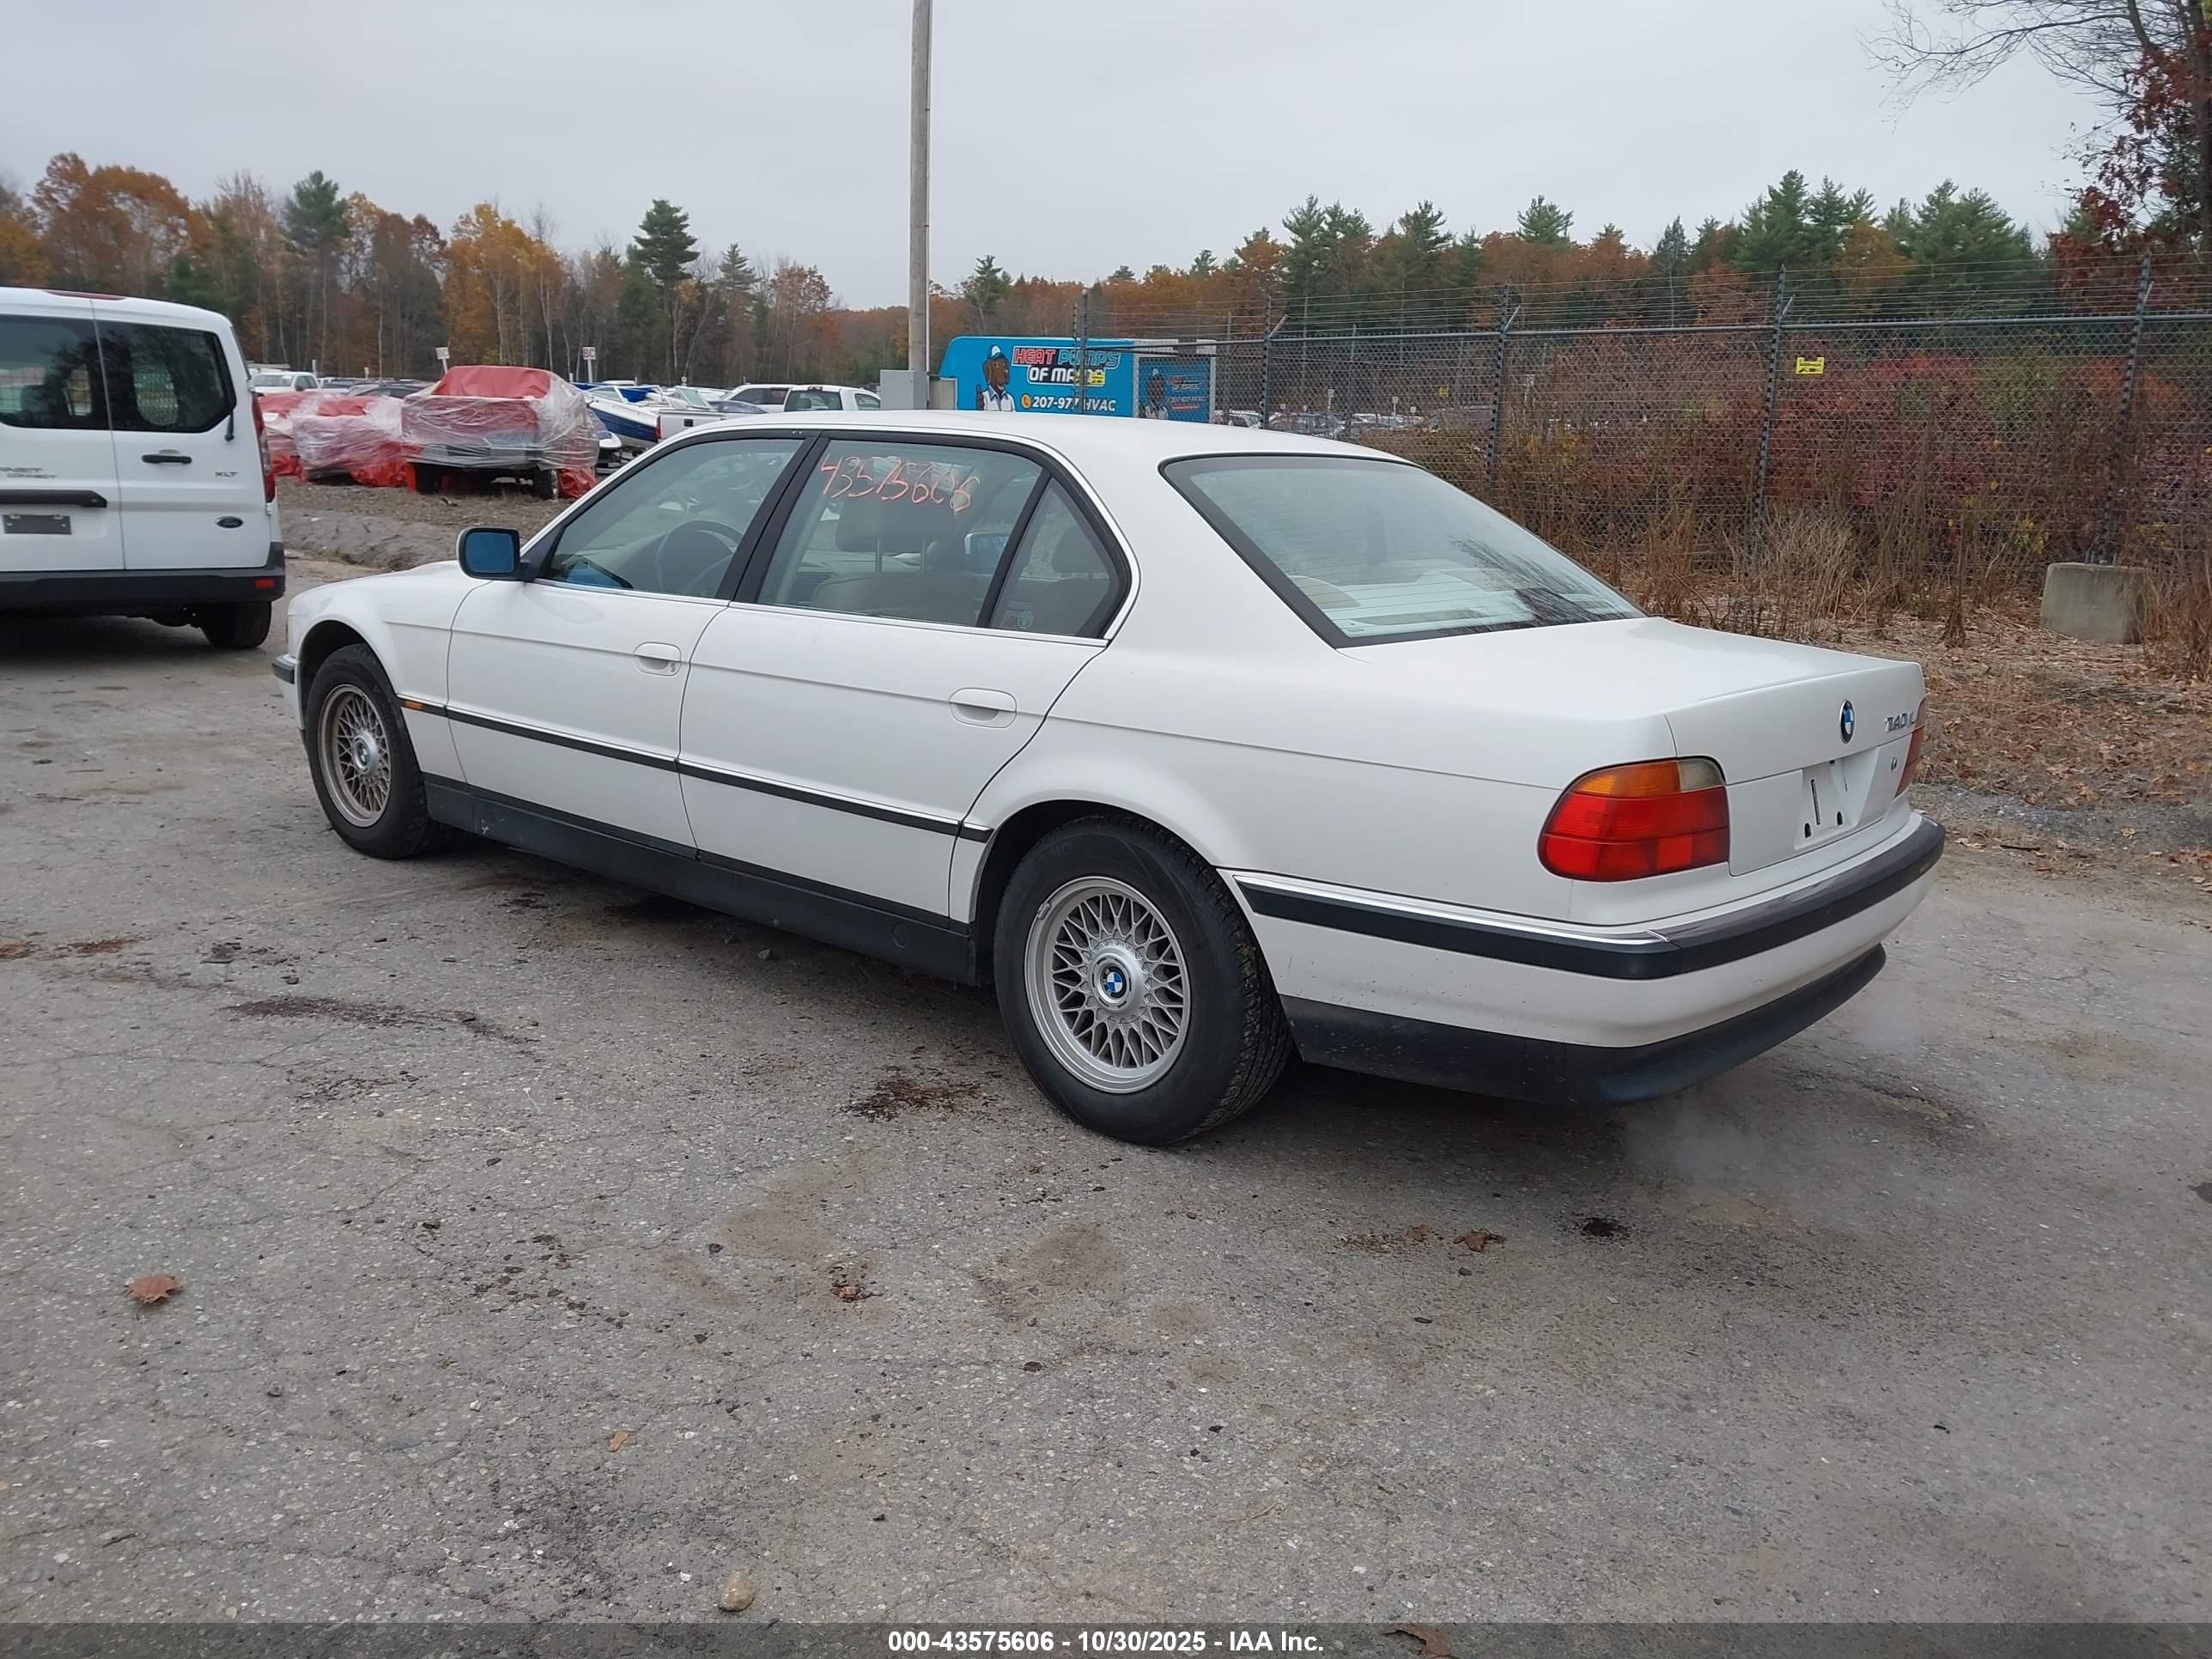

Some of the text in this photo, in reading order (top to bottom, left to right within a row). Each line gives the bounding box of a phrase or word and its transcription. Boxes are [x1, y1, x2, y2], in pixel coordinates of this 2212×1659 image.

[1013, 348, 1056, 365] HEAT
[1030, 367, 1049, 382] OF
[821, 453, 981, 512] 43575606
